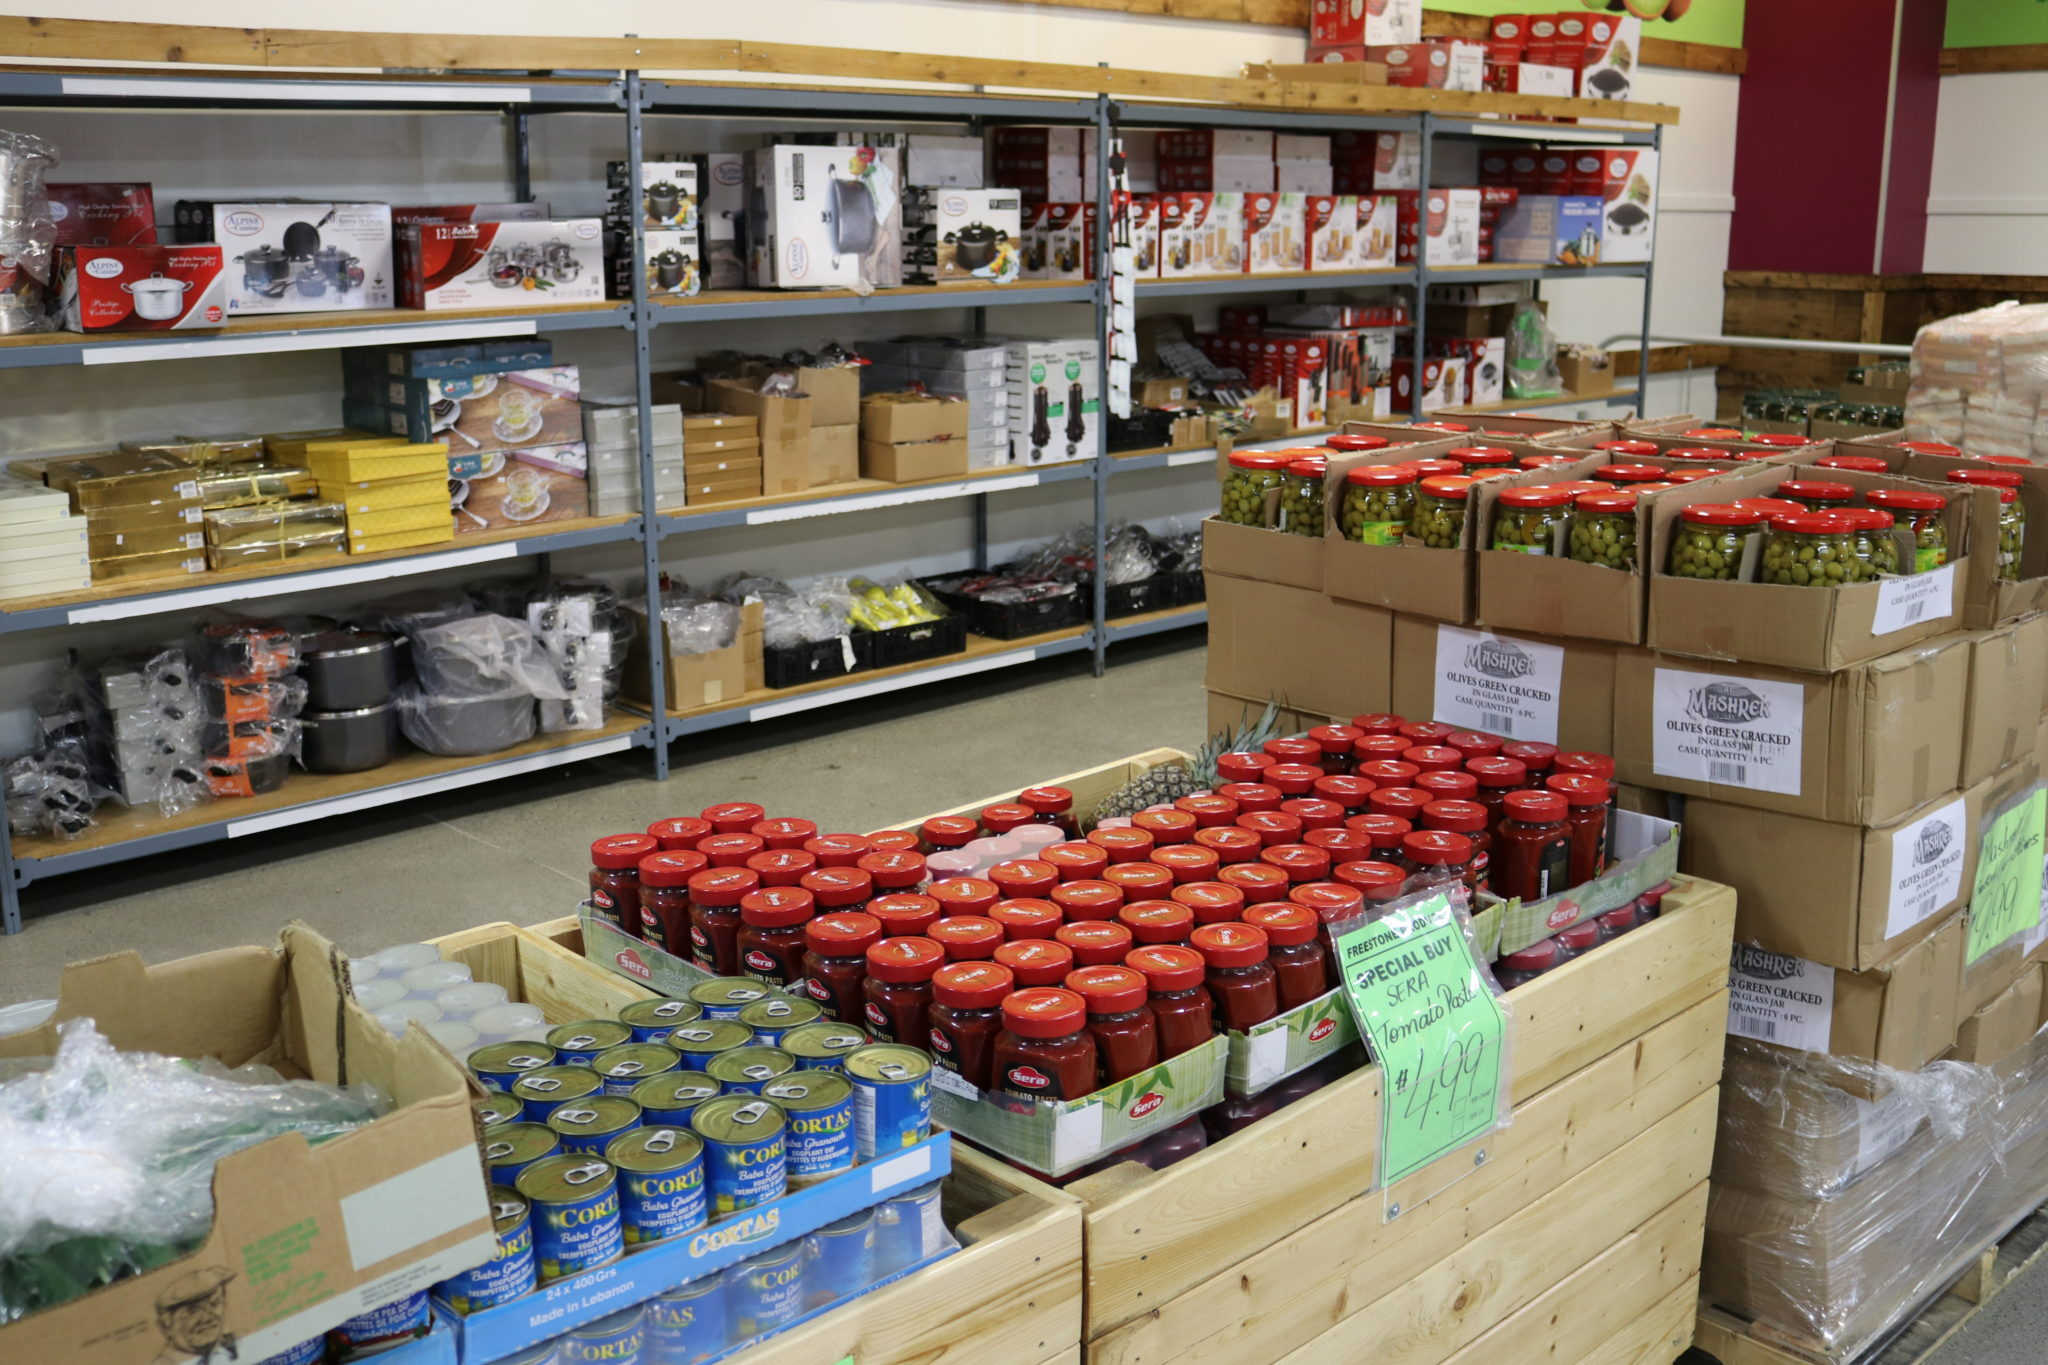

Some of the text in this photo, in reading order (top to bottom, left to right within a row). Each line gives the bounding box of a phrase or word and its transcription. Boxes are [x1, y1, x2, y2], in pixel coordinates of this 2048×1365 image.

[1464, 643, 1536, 677] MASHREK
[1446, 671, 1551, 702] OLIVES GREEN CRACKED
[1455, 695, 1474, 708] CASE
[1475, 698, 1514, 715] QUANTITY
[1472, 688, 1520, 705] IN GLASS JAR
[1685, 687, 1771, 721] MASHREK
[1666, 720, 1791, 745] OLIVES GREEN CRACKED
[1698, 736, 1708, 745] IN
[1708, 737, 1737, 750] GLASS
[1678, 745, 1700, 755] CASE
[1700, 747, 1747, 762] QUANTITY
[1549, 906, 1579, 925] Sera
[621, 955, 651, 978] Sera
[745, 955, 774, 969] Sera
[1356, 935, 1454, 991] SPECIAL BUY
[1386, 970, 1430, 1008] SERA
[1738, 980, 1772, 994] GREEN
[1774, 987, 1822, 1005] CRACKED
[1029, 996, 1061, 1011] Sera
[1733, 1001, 1777, 1018] QUANTITY
[1742, 994, 1768, 1004] GLASS
[1769, 998, 1784, 1008] JAR
[1312, 1022, 1336, 1040] Sera
[1376, 996, 1444, 1050] Tomato
[1010, 1071, 1046, 1086] Sera
[1134, 1097, 1162, 1115] Sera
[737, 1169, 764, 1181] Baba
[641, 1200, 669, 1212] Baba
[560, 1232, 589, 1244] Baba
[688, 1207, 780, 1259] CORTAS
[471, 1269, 500, 1282] Baba
[546, 1289, 561, 1301] 24
[573, 1276, 594, 1291] 400
[595, 1269, 617, 1283] Grs
[530, 1280, 635, 1327] Made in Lebanon
